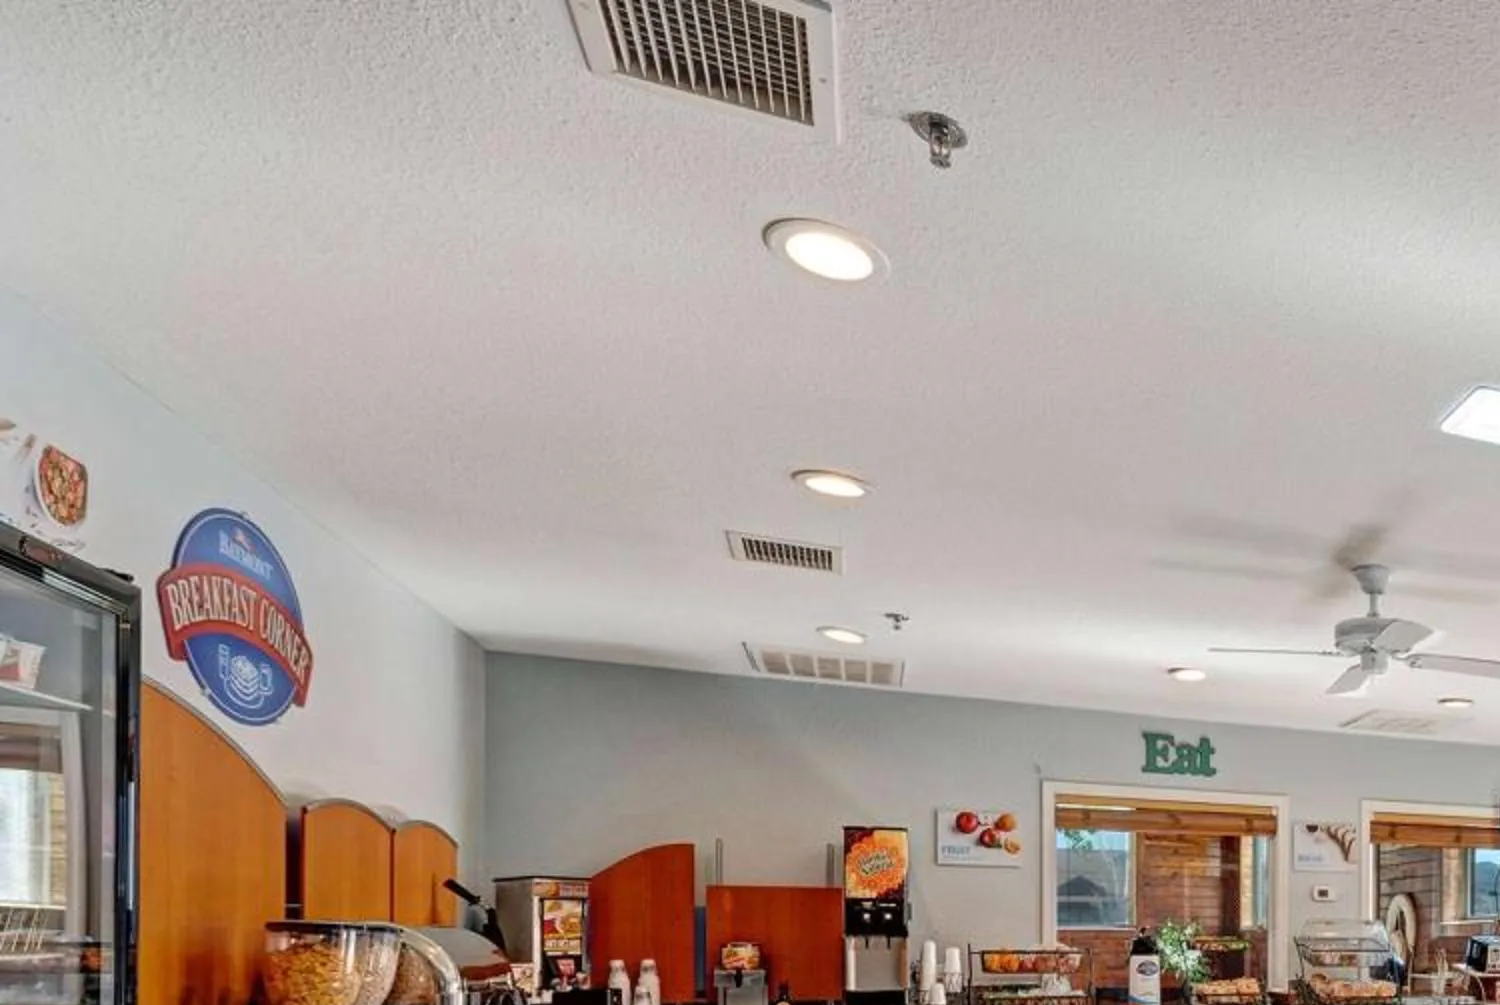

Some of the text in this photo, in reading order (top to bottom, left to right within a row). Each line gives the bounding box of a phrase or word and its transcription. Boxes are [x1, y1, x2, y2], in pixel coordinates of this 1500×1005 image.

[166, 574, 310, 686] BREAKFAST CORNER
[1141, 733, 1217, 777] Eat
